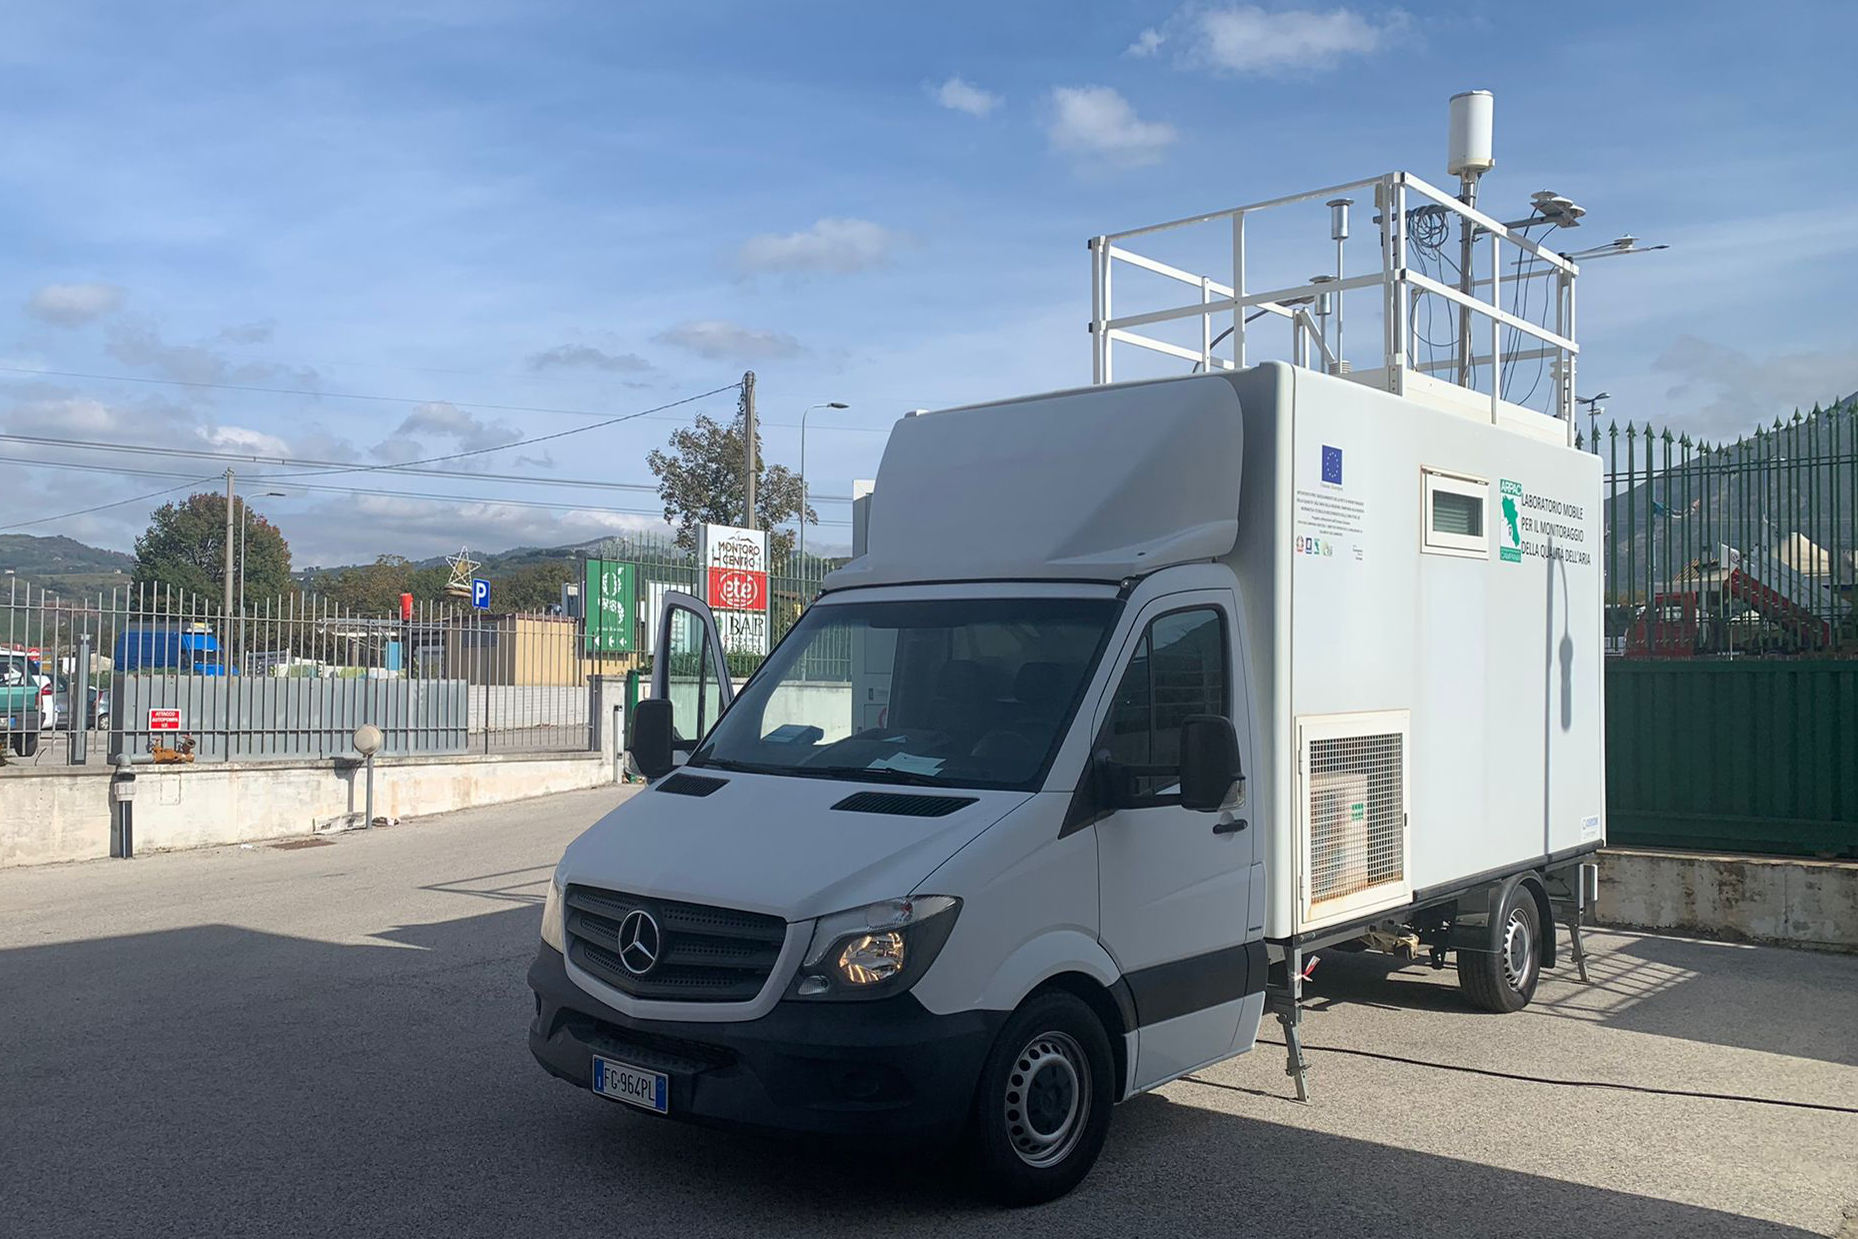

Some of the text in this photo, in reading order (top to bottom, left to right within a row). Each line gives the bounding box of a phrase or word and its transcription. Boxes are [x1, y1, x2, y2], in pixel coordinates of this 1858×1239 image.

[1501, 481, 1522, 494] ARPAC
[1521, 492, 1584, 520] LABORATORIO MOBILE
[1521, 516, 1585, 543] PER IL MONITORAGGIO
[718, 541, 761, 556] MONTORO
[1521, 540, 1540, 557] DELLA
[1564, 548, 1591, 566] DELL'ARIA
[722, 554, 756, 568] CENTRO
[475, 582, 487, 605] P
[730, 615, 764, 637] BAR
